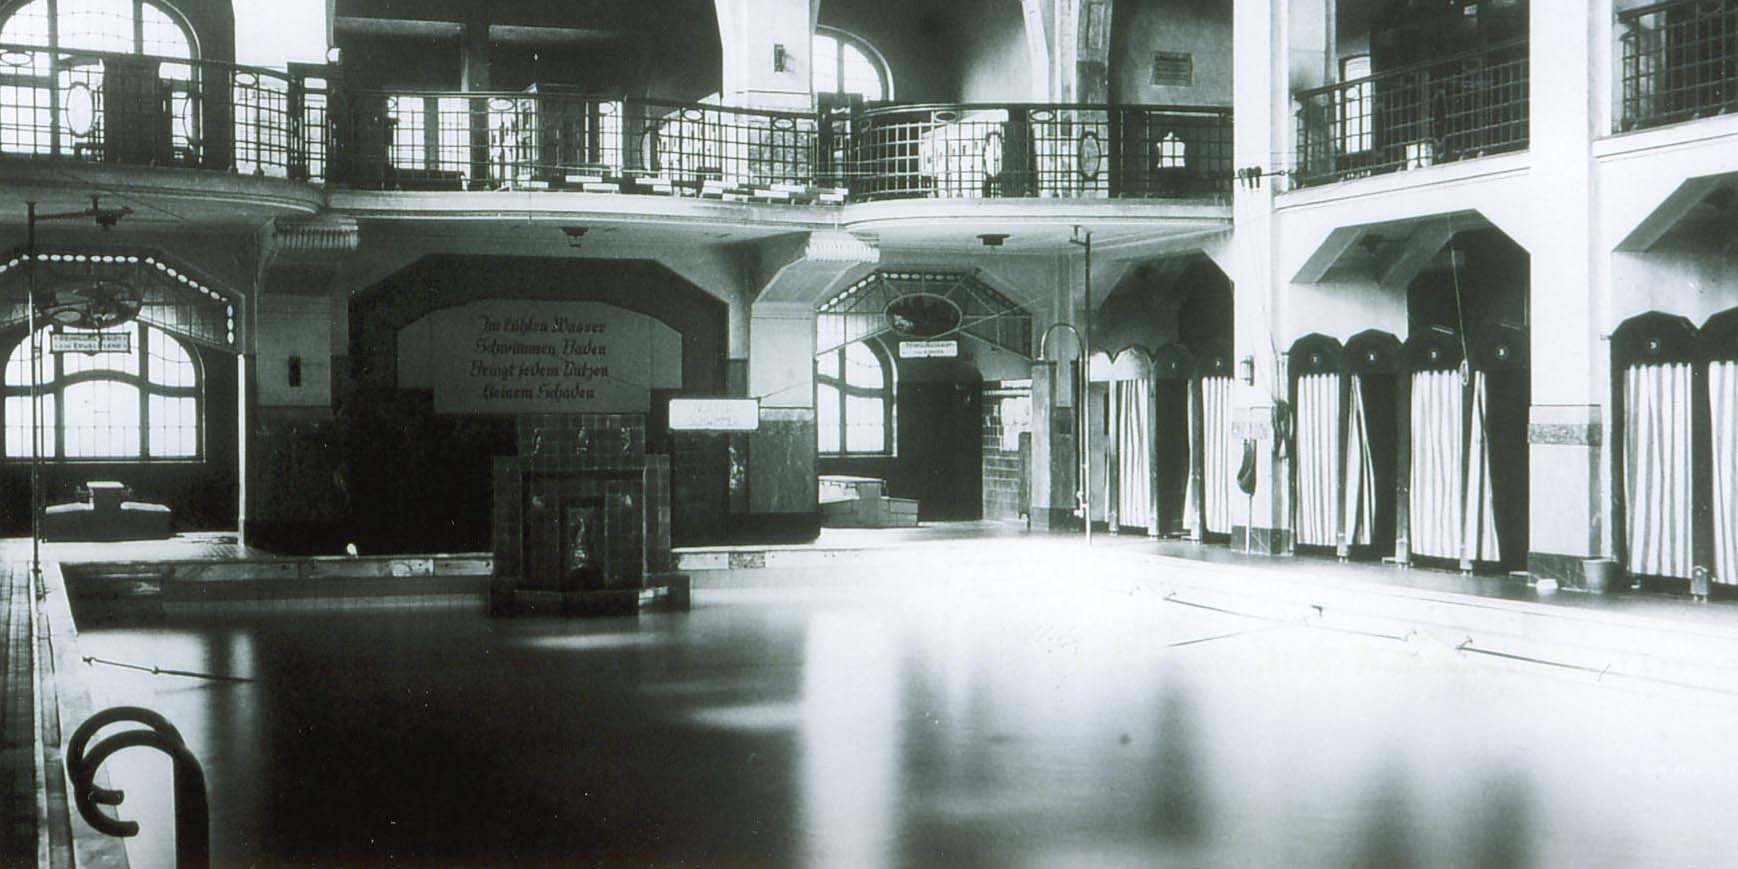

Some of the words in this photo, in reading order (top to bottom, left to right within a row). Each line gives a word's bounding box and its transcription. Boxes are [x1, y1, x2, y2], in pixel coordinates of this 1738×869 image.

[552, 315, 607, 333] Wasser
[562, 338, 607, 356] Baden
[470, 360, 515, 381] Bringt
[518, 360, 559, 380] jedem
[537, 383, 595, 402] Schaden
